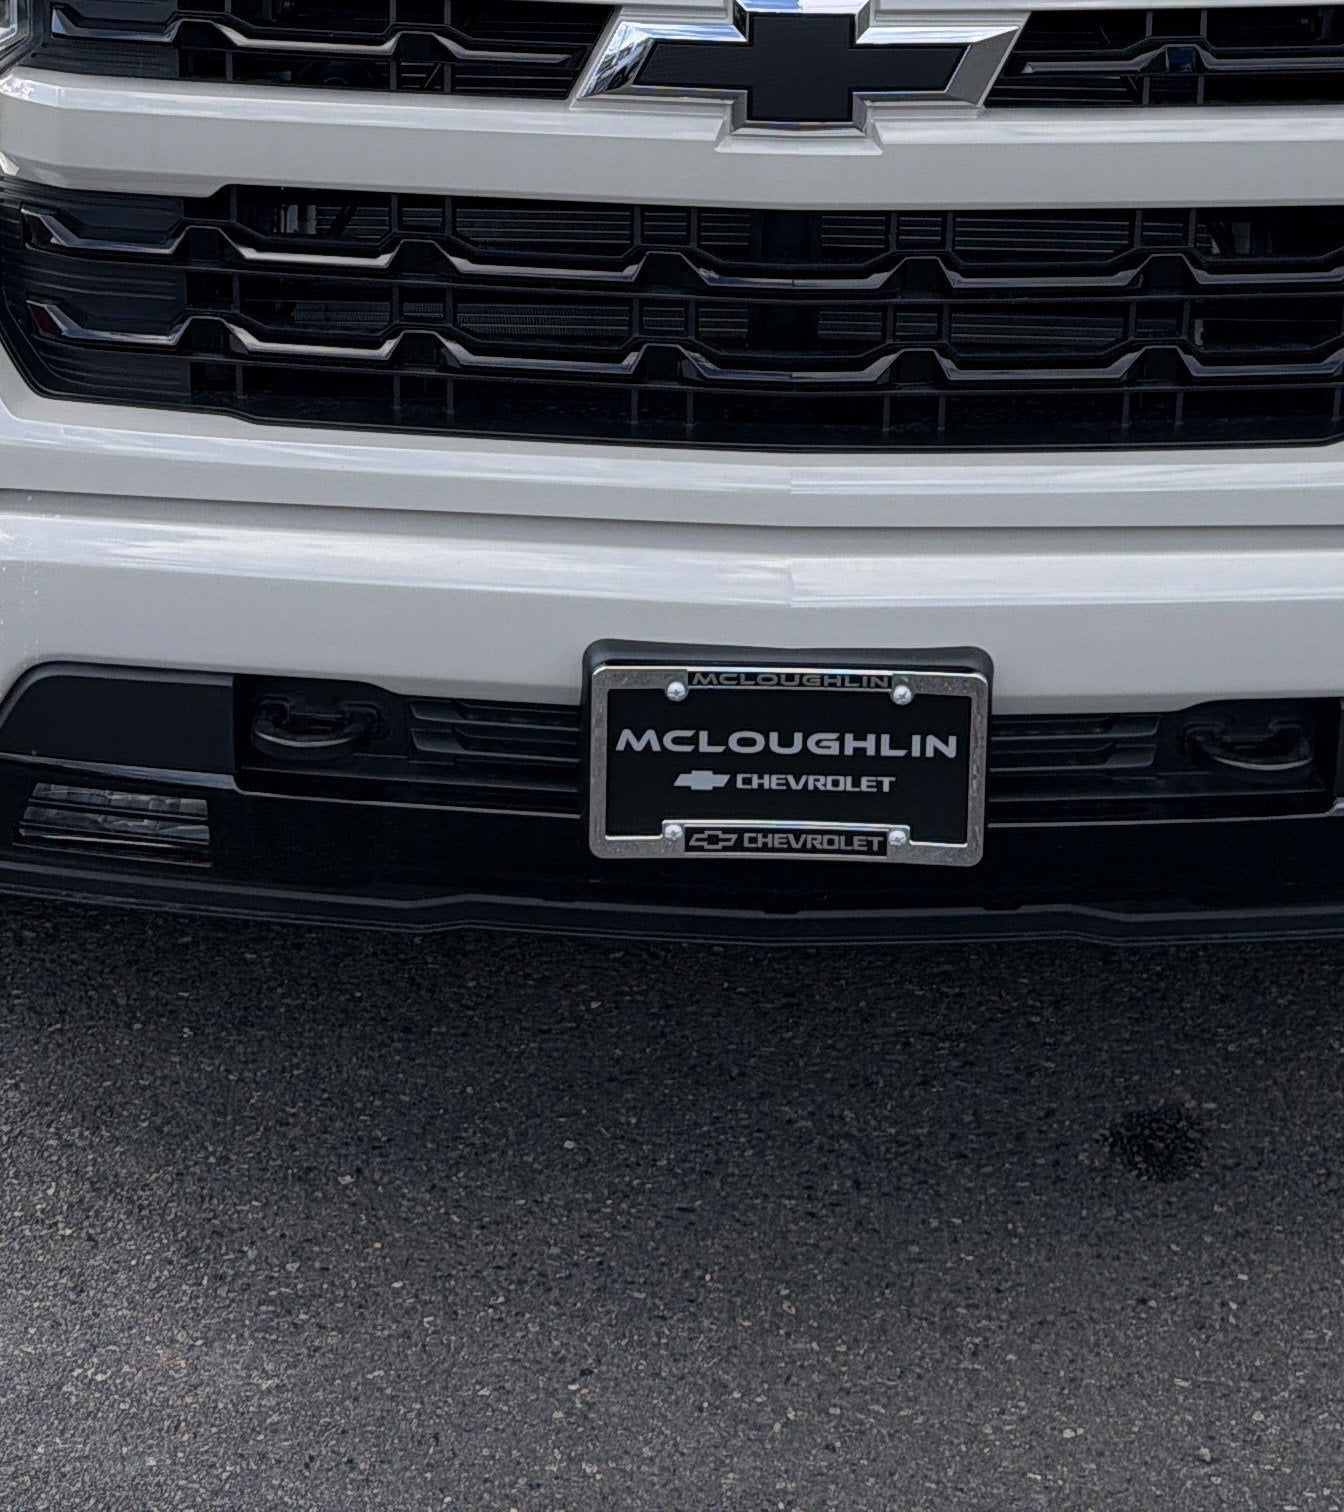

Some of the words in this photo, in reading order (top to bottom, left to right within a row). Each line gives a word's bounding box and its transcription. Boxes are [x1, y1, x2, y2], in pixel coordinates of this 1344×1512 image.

[690, 672, 891, 689] MCLOUGHLIN
[615, 728, 958, 760] MCLOUGHLIN
[736, 773, 896, 793] CHEVROLET
[743, 832, 884, 852] CHEVROLET
